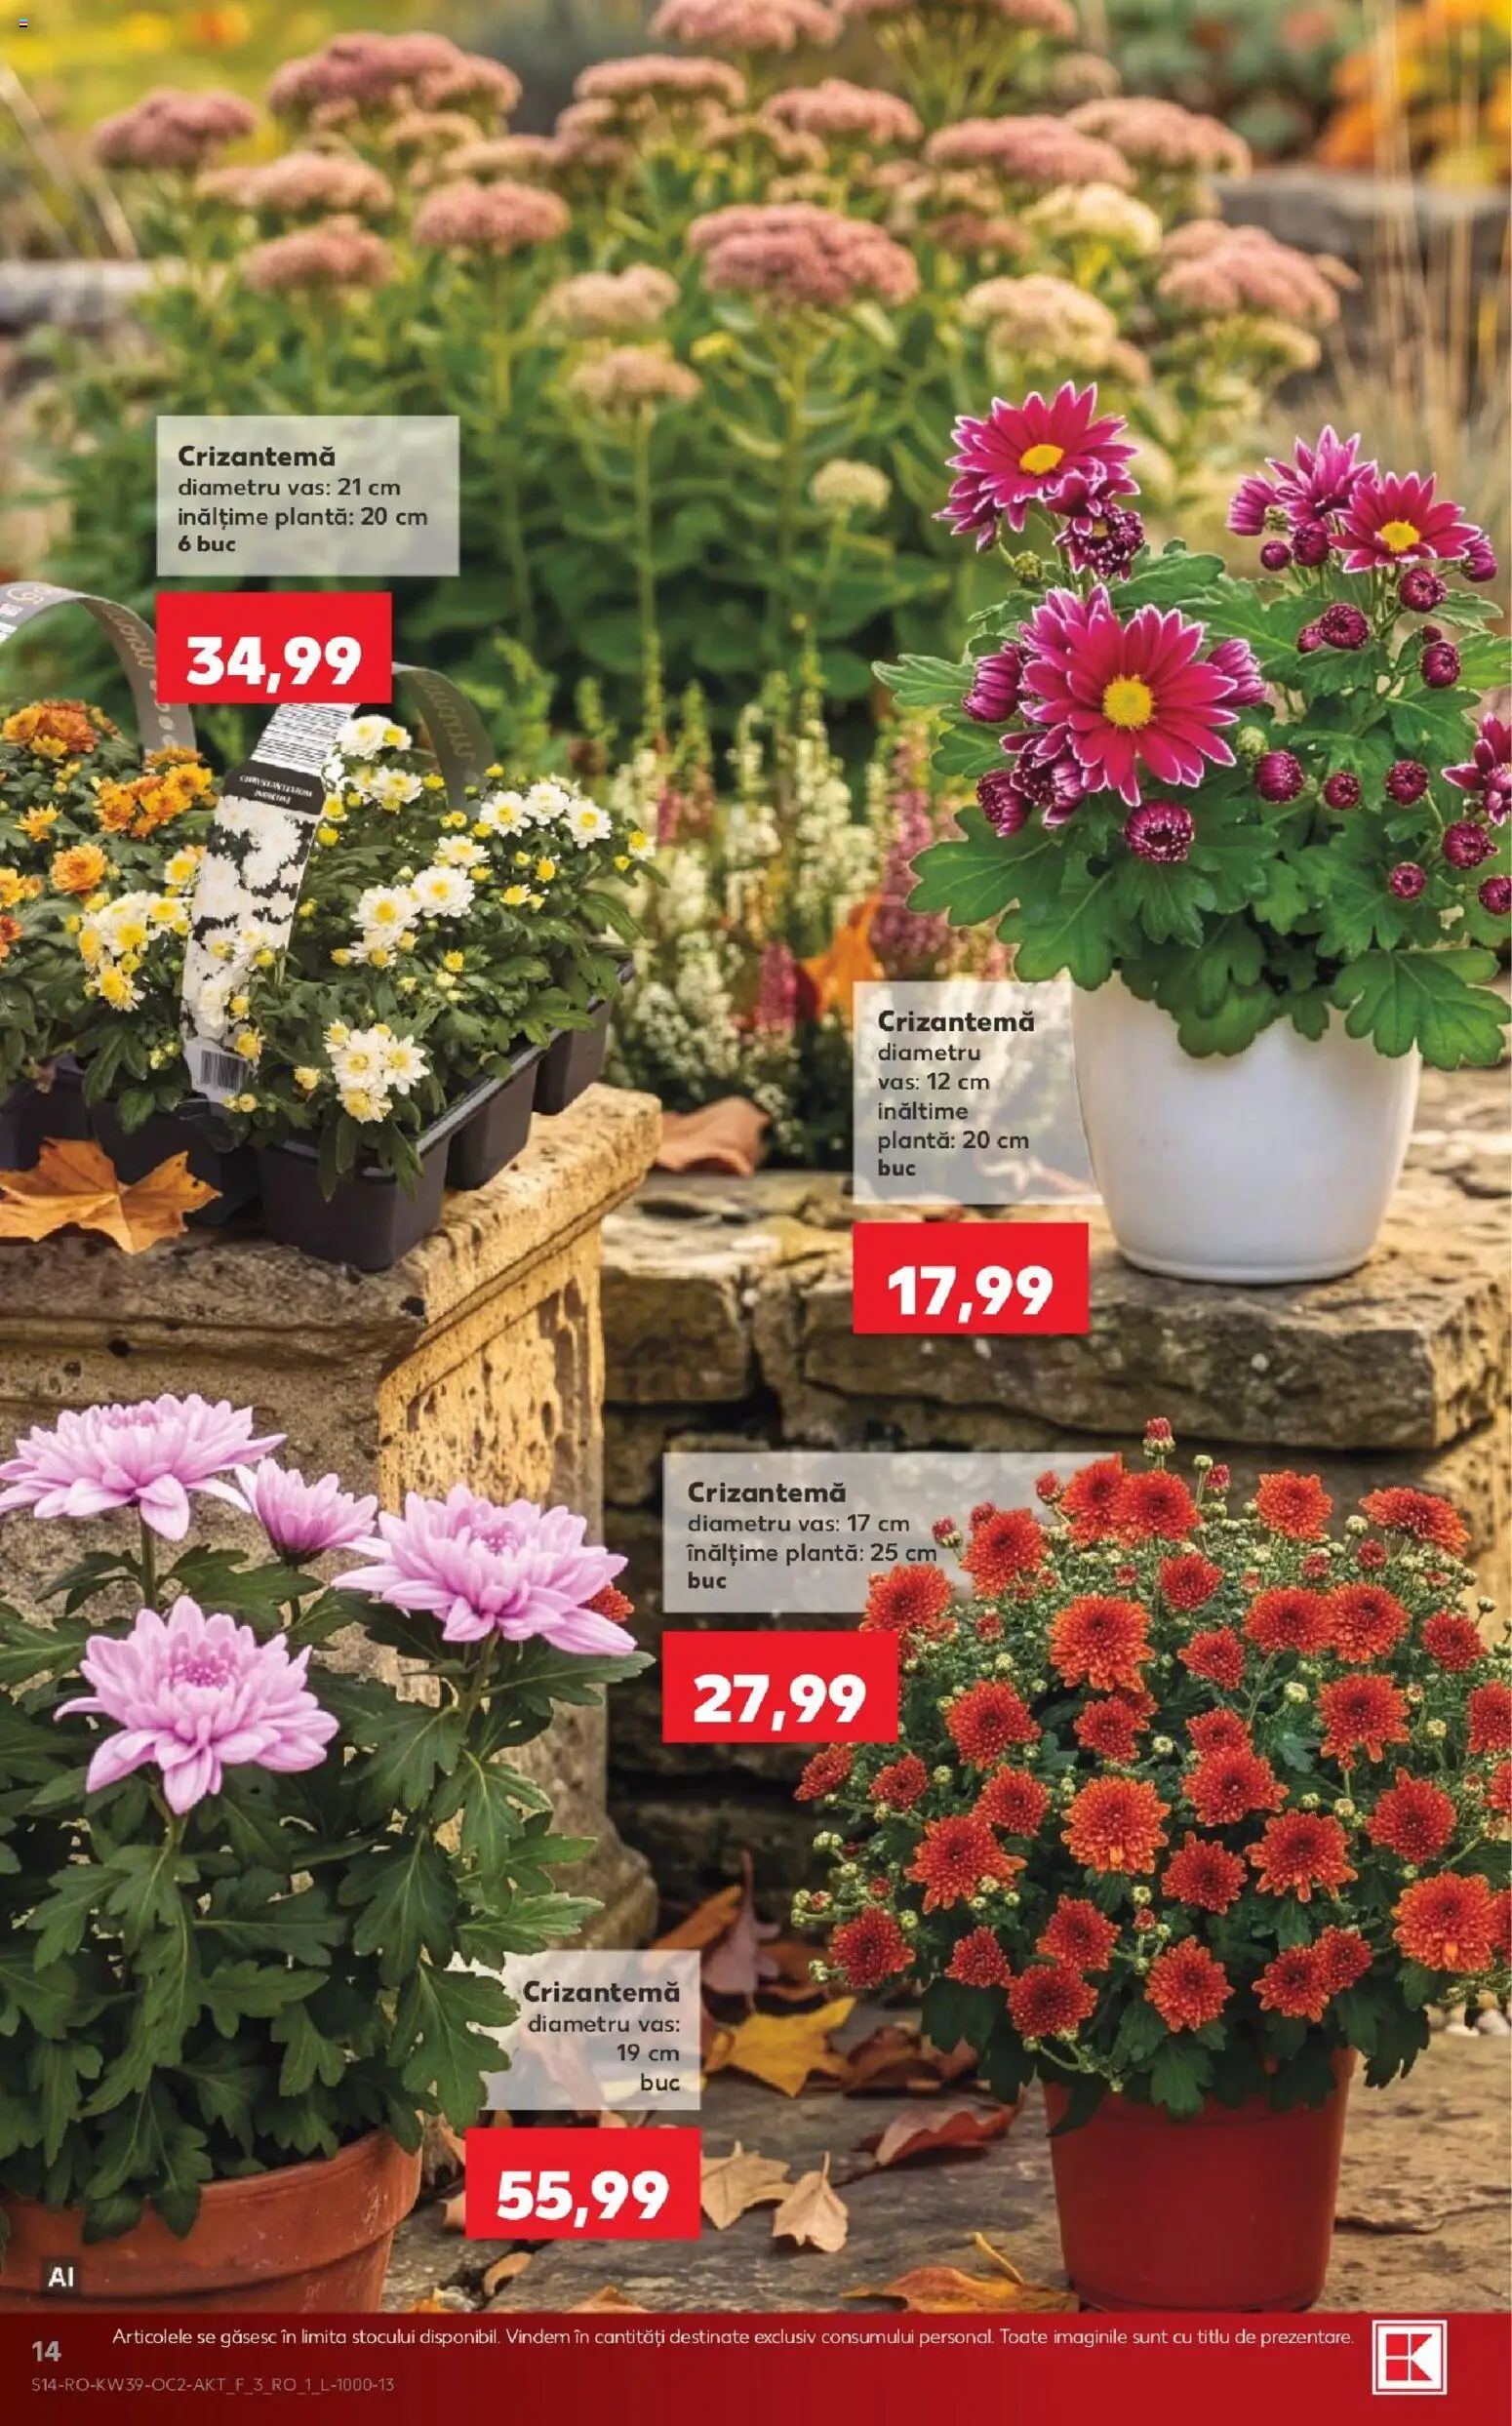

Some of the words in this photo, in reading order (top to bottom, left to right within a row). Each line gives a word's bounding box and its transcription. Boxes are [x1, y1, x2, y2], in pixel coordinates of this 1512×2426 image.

[178, 445, 336, 467] Crizantemă
[178, 477, 280, 497] diametru
[287, 483, 331, 497] vas:
[337, 477, 361, 497] 21
[368, 483, 401, 497] cm
[178, 506, 268, 531] inălțime
[275, 506, 354, 531] plantă:
[360, 506, 388, 526] 20
[395, 511, 428, 526] cm
[178, 535, 192, 552] 6
[197, 535, 236, 552] buc
[186, 636, 362, 694] 34,99
[878, 1010, 1035, 1032] Crizantemă
[878, 1042, 980, 1061] diametru
[878, 1077, 920, 1091] vas:
[927, 1072, 951, 1091] 12
[957, 1077, 990, 1091] cm
[878, 1100, 969, 1121] inăltime
[878, 1130, 955, 1154] plantă:
[962, 1130, 991, 1149] 20
[996, 1135, 1029, 1149] cm
[877, 1158, 917, 1177] buc
[889, 1265, 1054, 1323] 17,99
[688, 1481, 847, 1503] Crizantemă
[687, 1513, 791, 1532] diametru
[798, 1519, 840, 1532] vas:
[847, 1513, 871, 1532] 17
[878, 1519, 910, 1532] cm
[686, 1542, 778, 1567] înălțime
[785, 1542, 864, 1567] plantă:
[870, 1542, 898, 1562] 25
[905, 1548, 937, 1562] cm
[688, 1571, 727, 1590] buc
[694, 1674, 866, 1731] 27,99
[522, 1980, 680, 2003] Crizantemă
[527, 2013, 630, 2033] diametru
[638, 2019, 680, 2033] vas:
[617, 2043, 641, 2062] 19
[648, 2048, 680, 2062] cm
[640, 2072, 681, 2092] buc
[497, 2170, 669, 2228] 55,99
[112, 2328, 193, 2344] Articolele
[197, 2332, 217, 2344] se
[219, 2328, 277, 2348] găsesc
[280, 2328, 297, 2344] în
[301, 2328, 346, 2344] limita
[352, 2328, 416, 2344] stocului
[419, 2328, 500, 2348] disponibil.
[505, 2328, 571, 2344] Vindem
[574, 2328, 589, 2344] în
[594, 2328, 665, 2348] cantități
[669, 2328, 750, 2344] destinate
[754, 2328, 816, 2344] exclusiv
[821, 2328, 914, 2344] consumului
[919, 2328, 994, 2348] personal.
[999, 2328, 1048, 2344] Toate
[1054, 2328, 1128, 2348] imaginile
[1133, 2330, 1169, 2344] sunt
[1173, 2332, 1192, 2344] cu
[1198, 2328, 1230, 2344] titlu
[1235, 2328, 1256, 2344] de
[1260, 2331, 1354, 2348] prezentare.
[31, 2340, 61, 2363] 14
